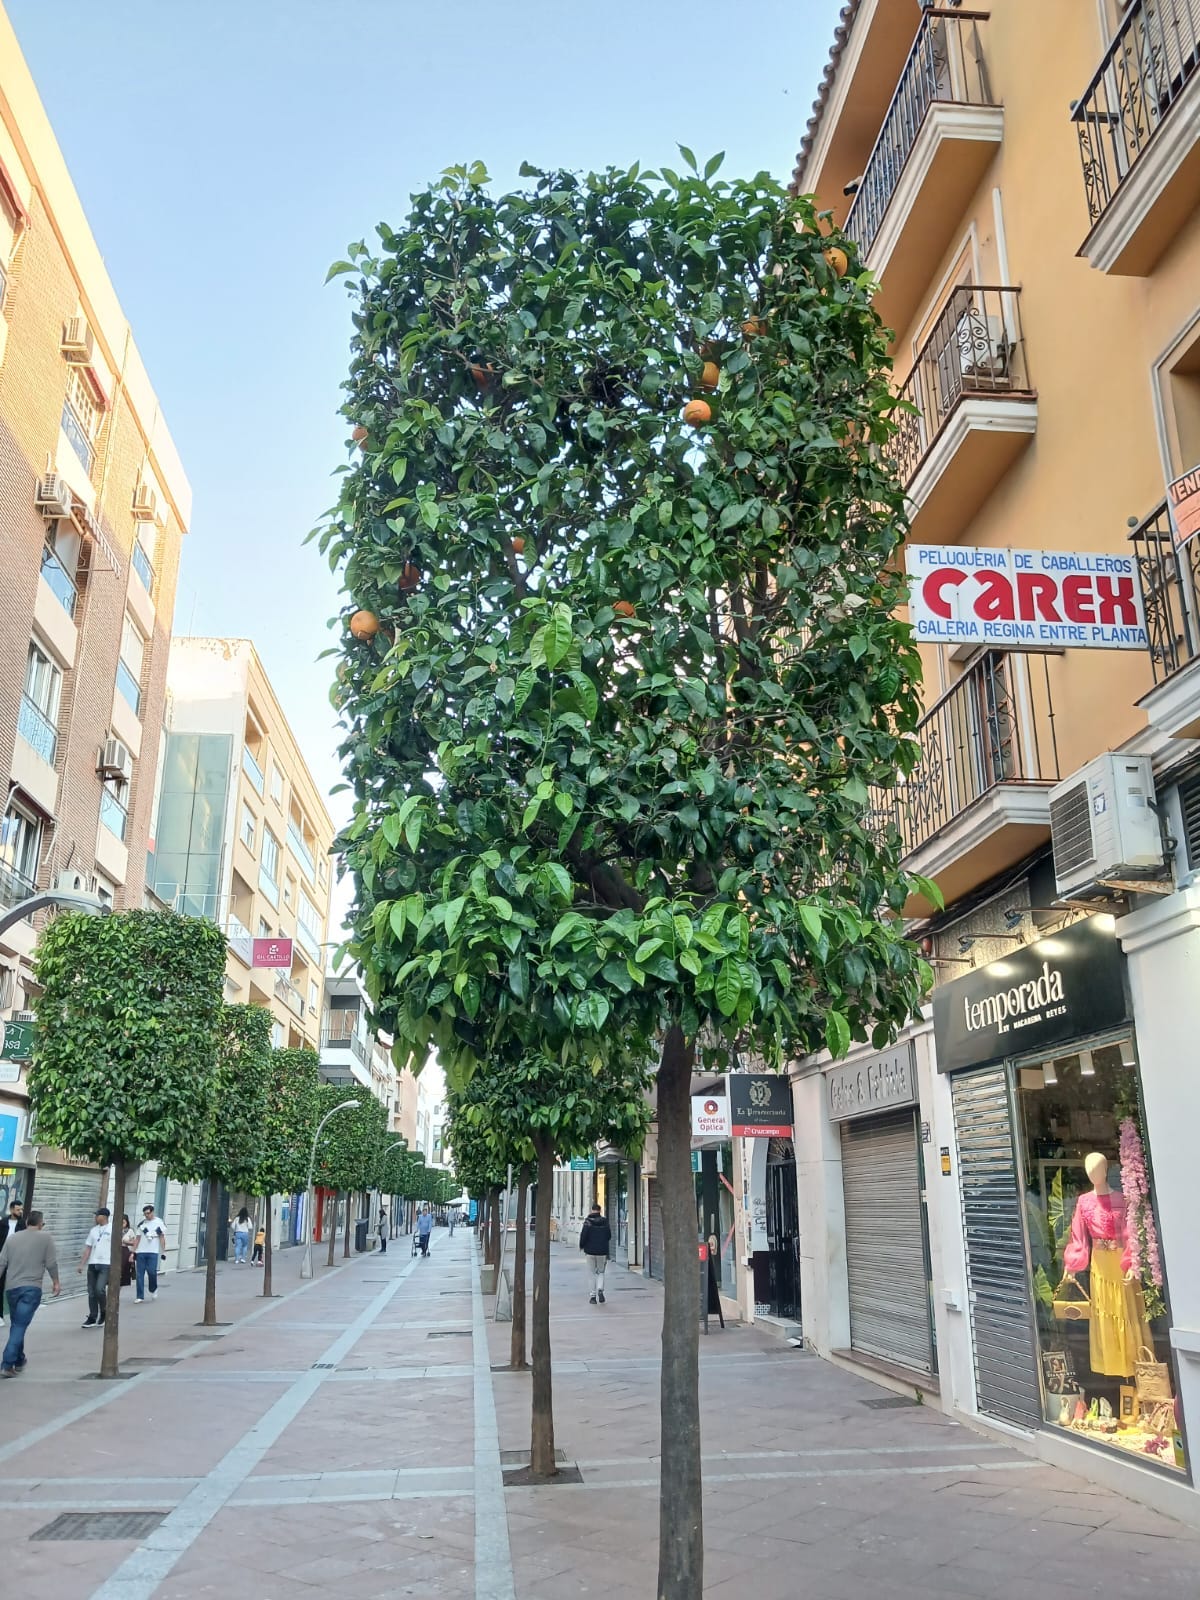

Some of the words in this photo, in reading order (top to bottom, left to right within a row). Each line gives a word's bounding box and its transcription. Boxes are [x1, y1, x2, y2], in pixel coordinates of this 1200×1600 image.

[919, 550, 1006, 568] PELUQUERIA
[1014, 554, 1033, 569] DE
[1041, 555, 1132, 573] CABALLEROS
[918, 620, 979, 636] GALERIA
[984, 622, 1035, 639] REGINA
[1040, 624, 1087, 640] ENTRE
[1092, 626, 1147, 643] PLANTA
[964, 961, 1065, 1034] temporada
[1045, 1005, 1067, 1019] REYES
[697, 1116, 726, 1124] General
